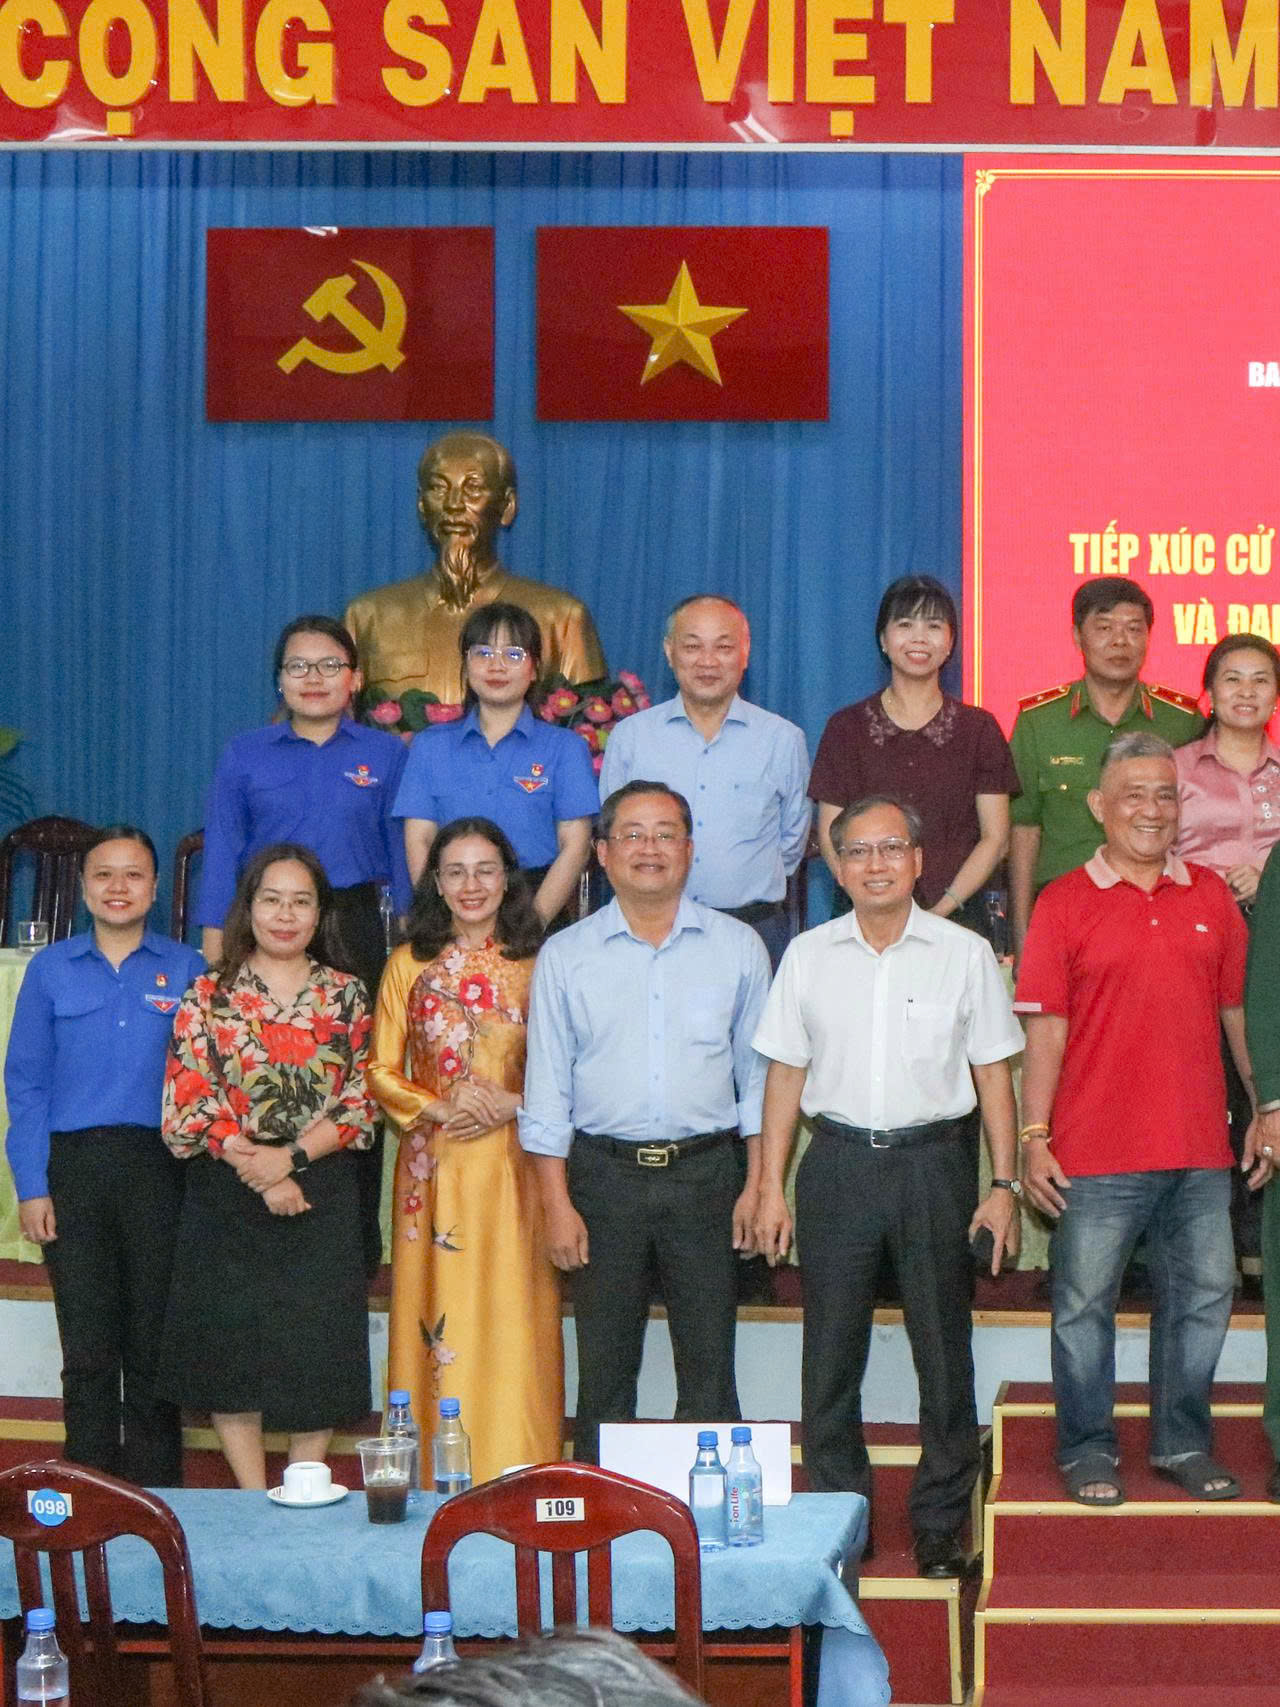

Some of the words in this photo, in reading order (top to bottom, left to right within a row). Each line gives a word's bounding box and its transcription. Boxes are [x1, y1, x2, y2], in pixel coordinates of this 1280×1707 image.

[1009, 0, 1280, 110] NAM
[1068, 519, 1140, 575] TIẾP
[1148, 526, 1216, 576] XÚC
[1225, 523, 1276, 576] CỬ
[1172, 597, 1218, 645] VÀ
[34, 1499, 66, 1516] 098
[545, 1499, 575, 1516] 109
